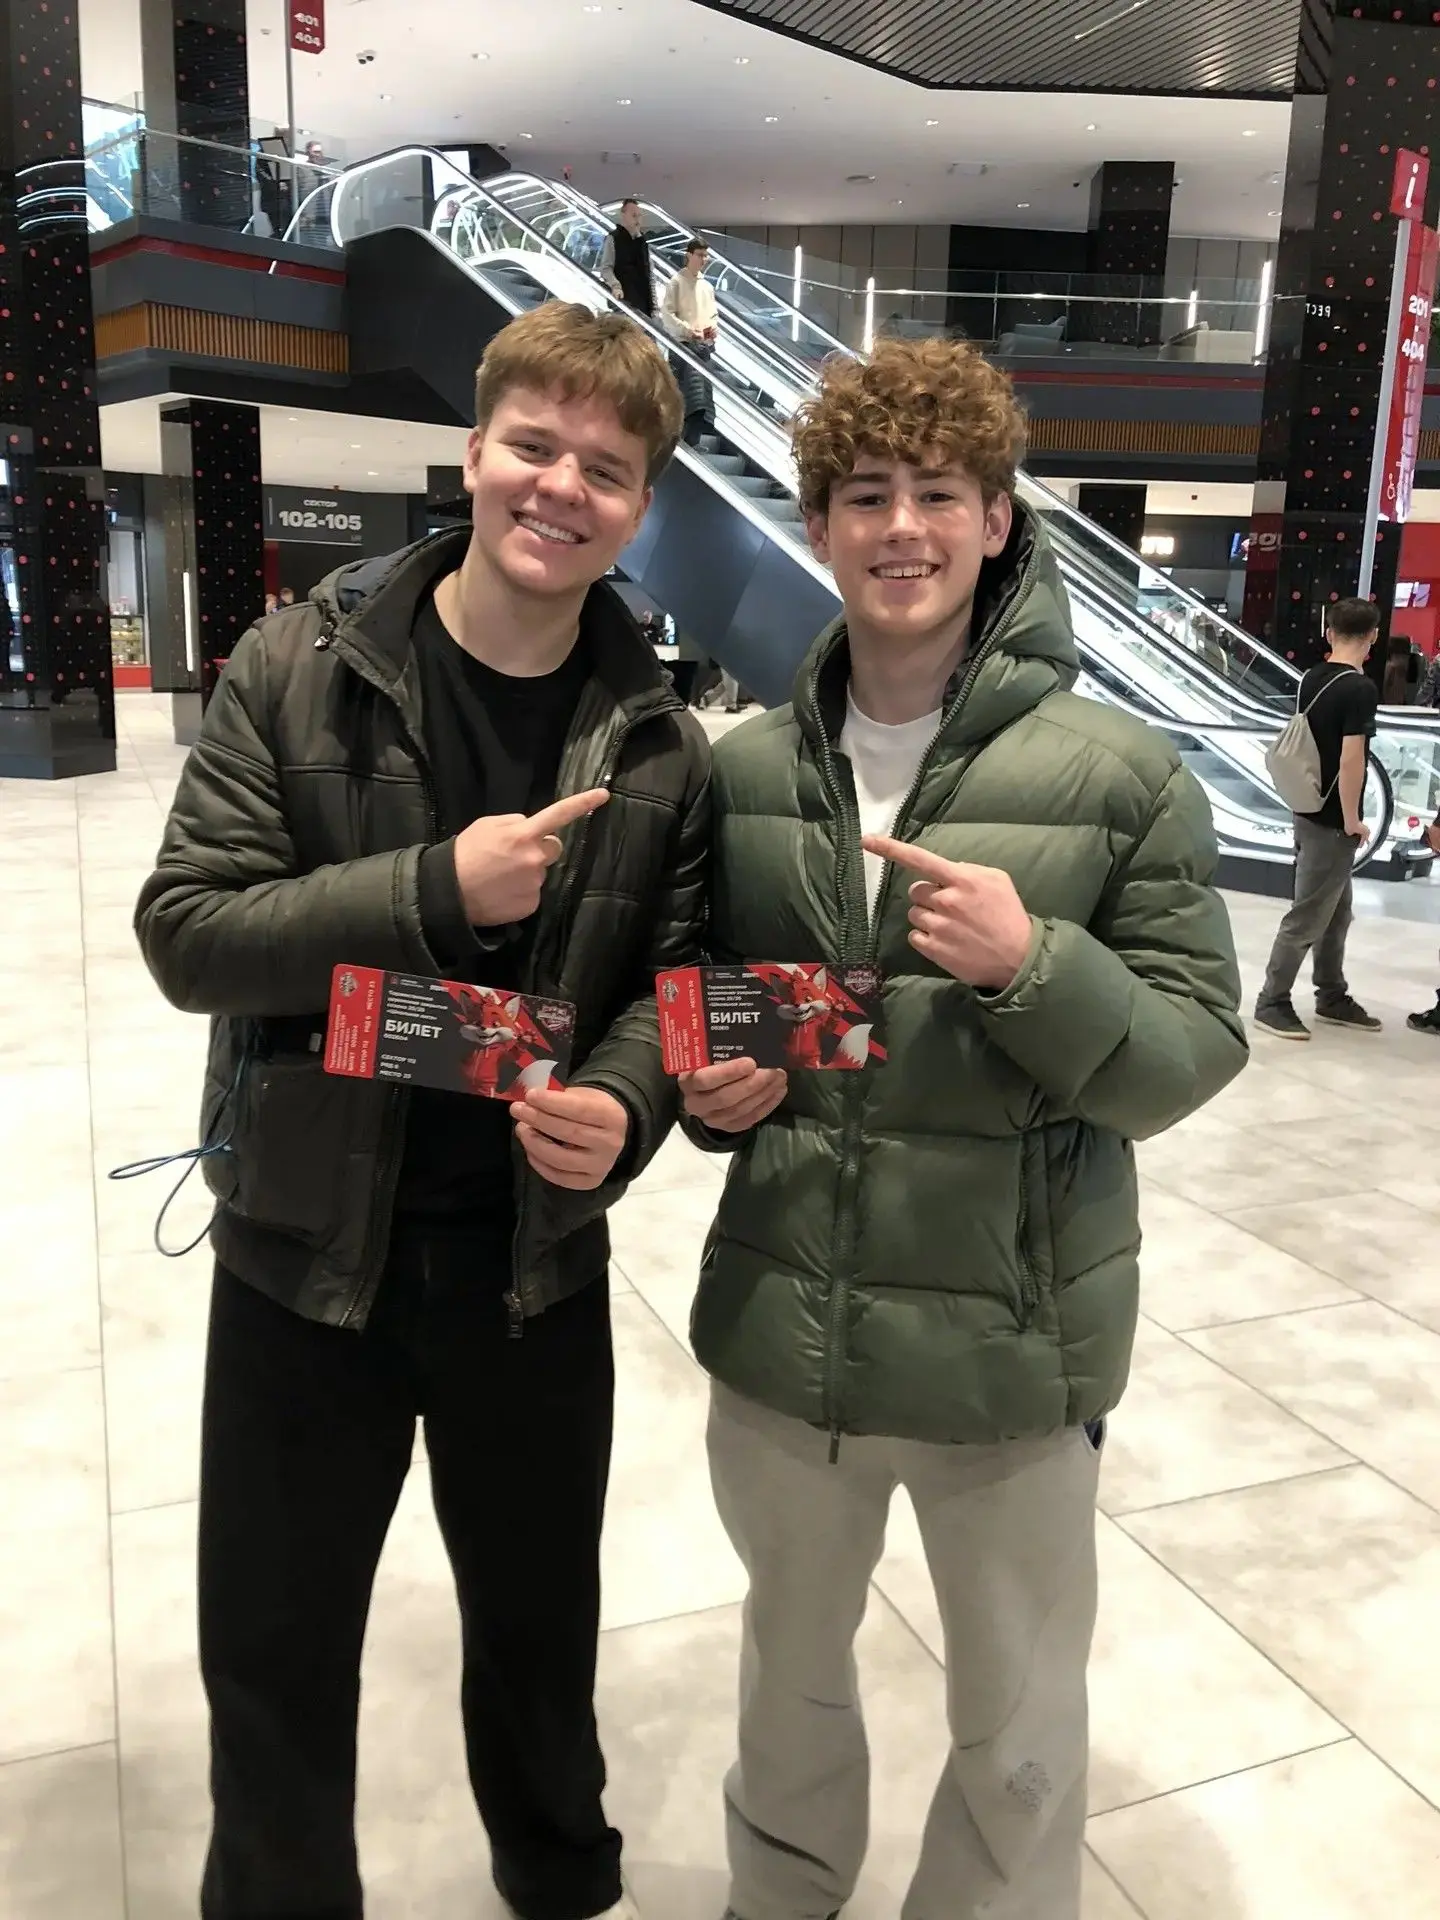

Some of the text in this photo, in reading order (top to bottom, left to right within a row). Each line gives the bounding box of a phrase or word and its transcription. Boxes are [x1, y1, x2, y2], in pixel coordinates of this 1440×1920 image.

[1408, 294, 1429, 318] 201
[1401, 338, 1425, 362] 404
[303, 499, 338, 508] СЕКТОР
[278, 510, 362, 531] 102-105
[710, 1011, 761, 1024] БИЛЕТ
[385, 1019, 443, 1039] БИЛЕТ
